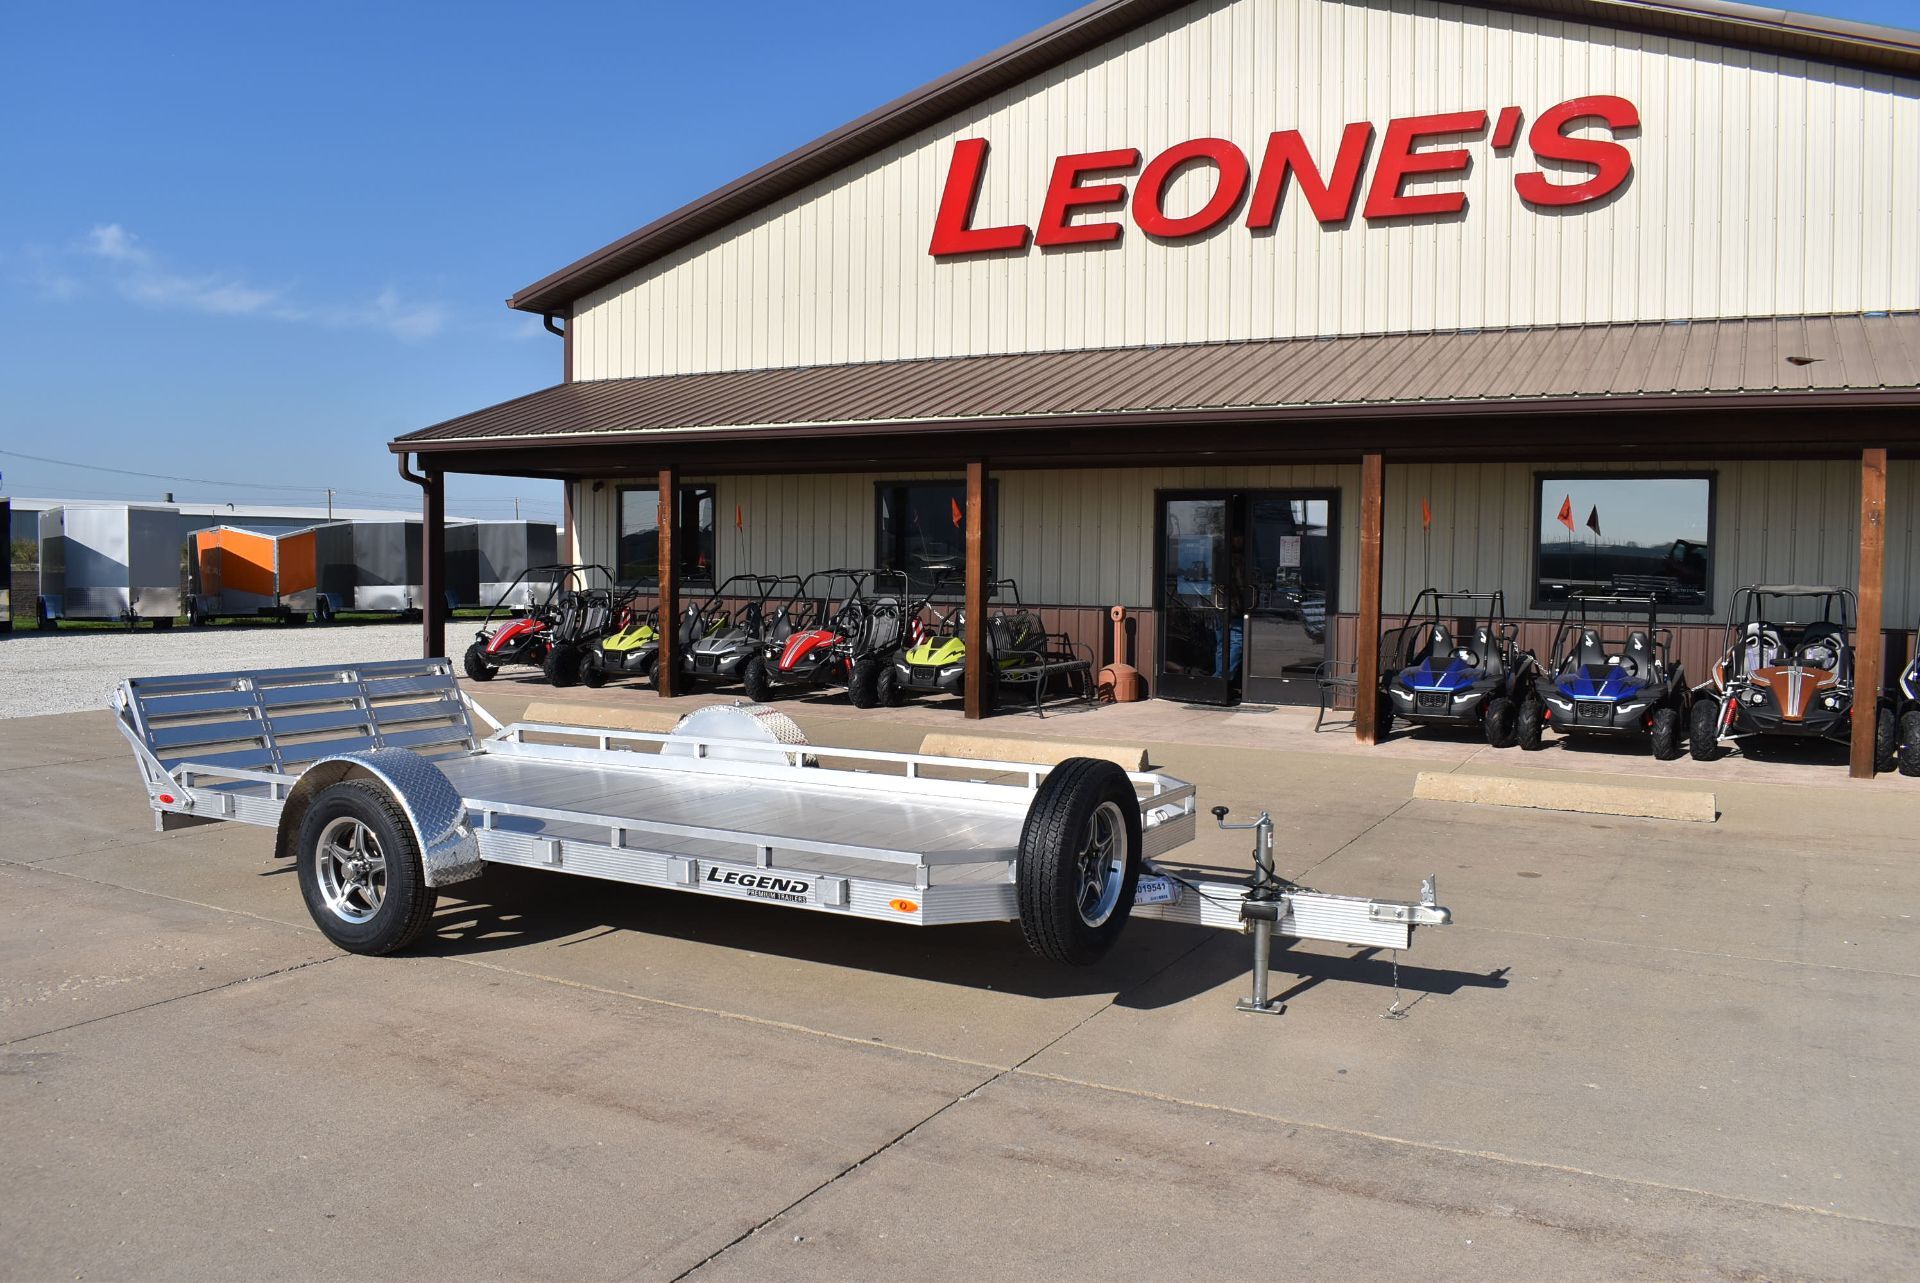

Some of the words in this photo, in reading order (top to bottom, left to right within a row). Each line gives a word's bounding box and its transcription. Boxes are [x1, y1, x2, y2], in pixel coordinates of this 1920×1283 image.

[928, 95, 1640, 256] LEONE'S
[707, 867, 809, 893] LEGEND
[747, 888, 776, 900] PREMIUM
[778, 893, 808, 904] TRAILERS
